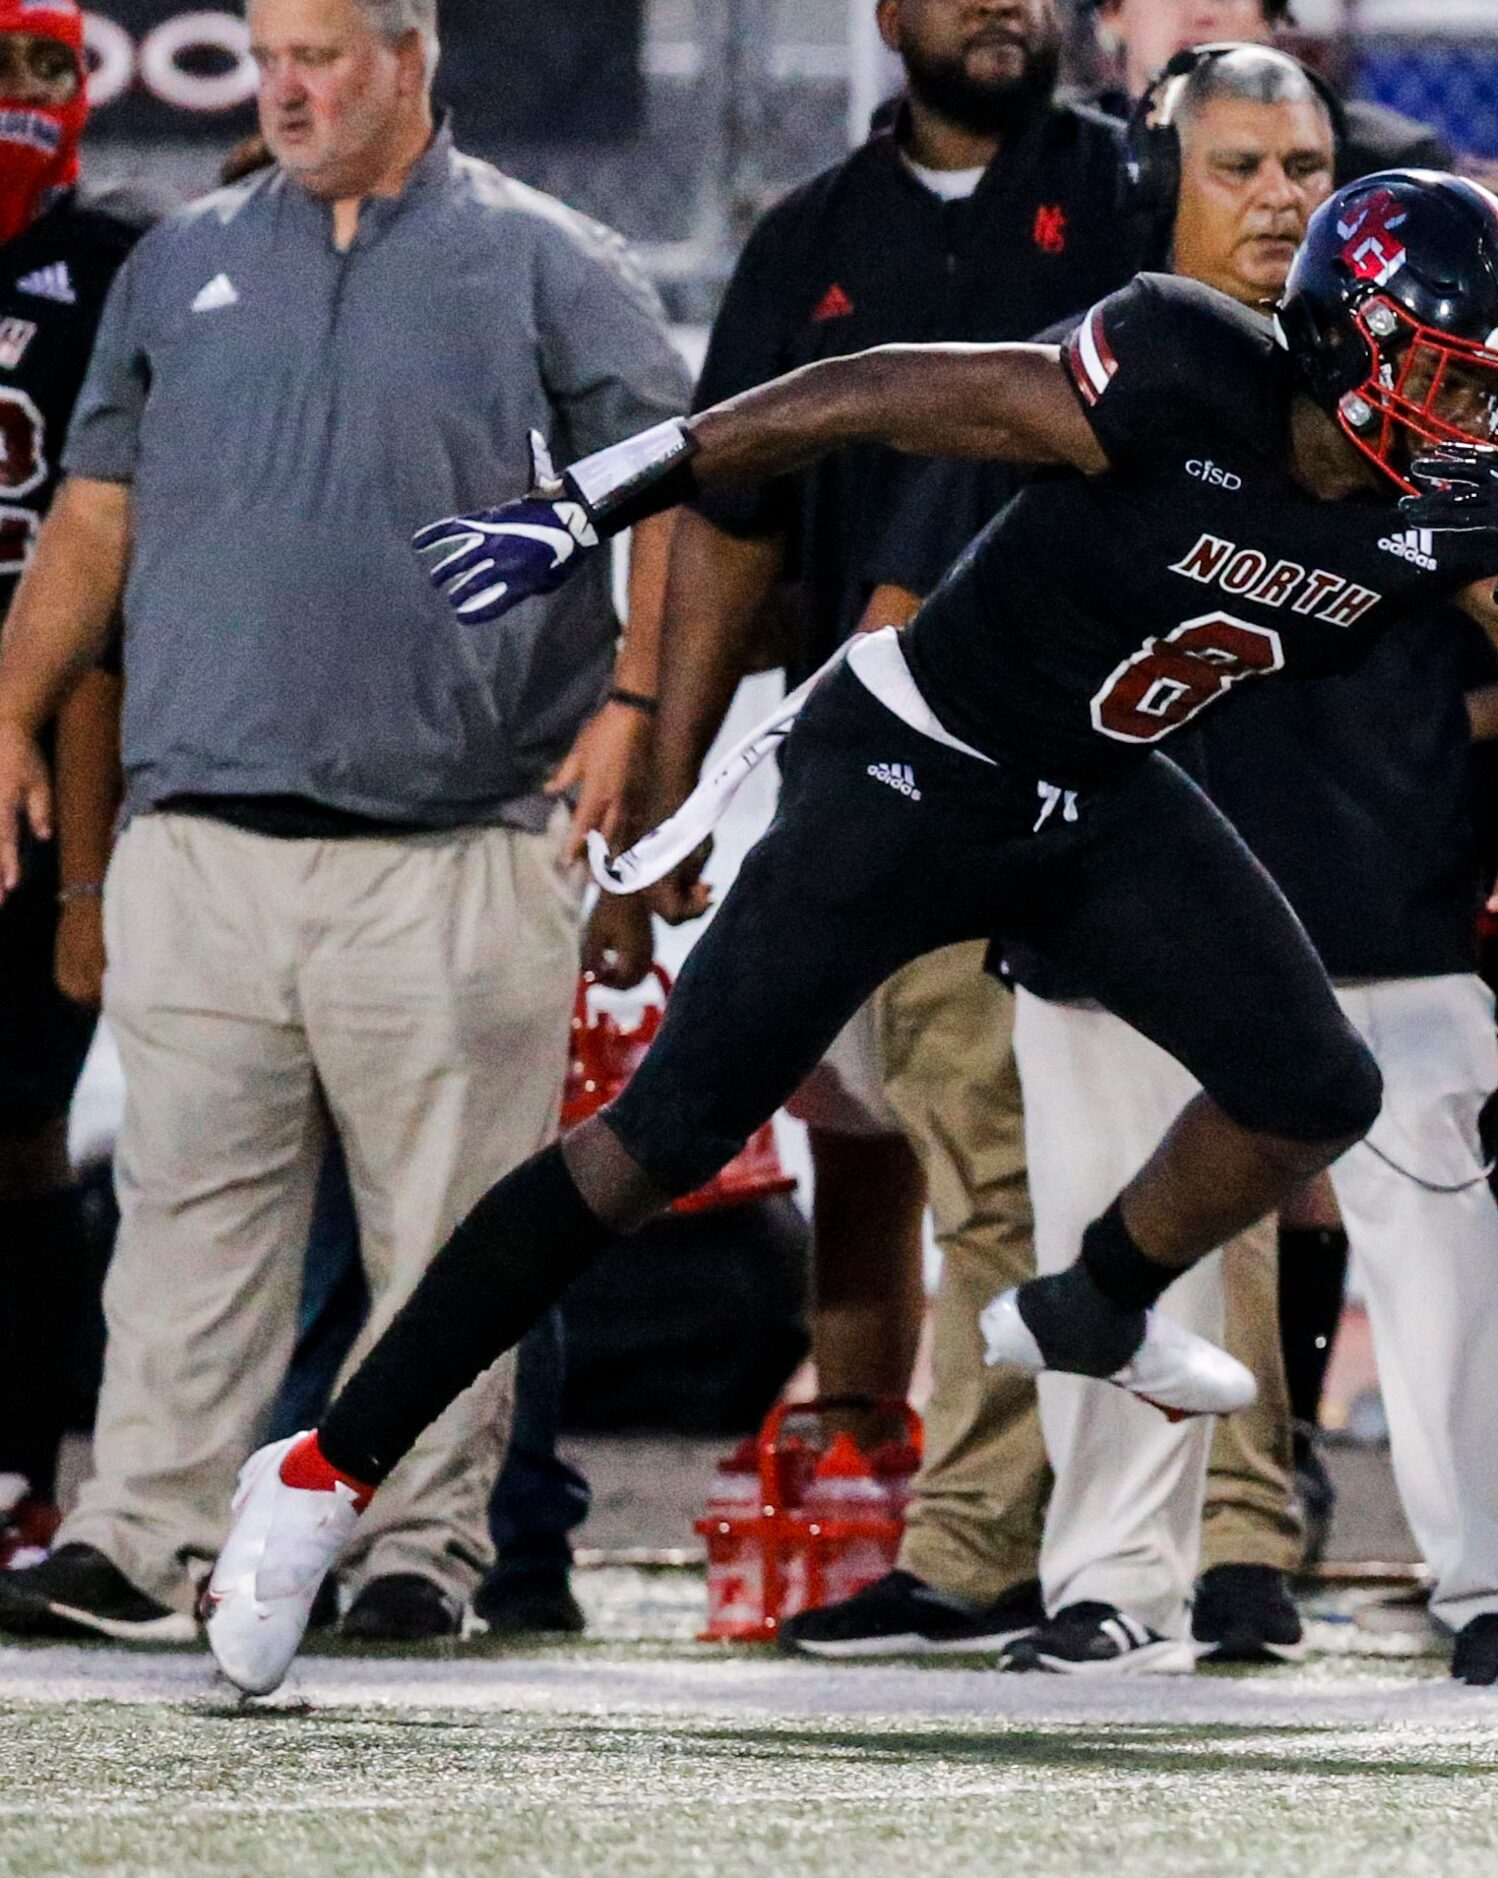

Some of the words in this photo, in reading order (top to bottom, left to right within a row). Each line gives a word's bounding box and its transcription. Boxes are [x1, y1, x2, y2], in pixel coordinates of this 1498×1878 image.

[1185, 459, 1242, 490] GISD
[1377, 537, 1437, 571] adidas
[1168, 533, 1382, 627] NORTH
[1090, 610, 1285, 744] 8
[867, 764, 921, 801] adidas
